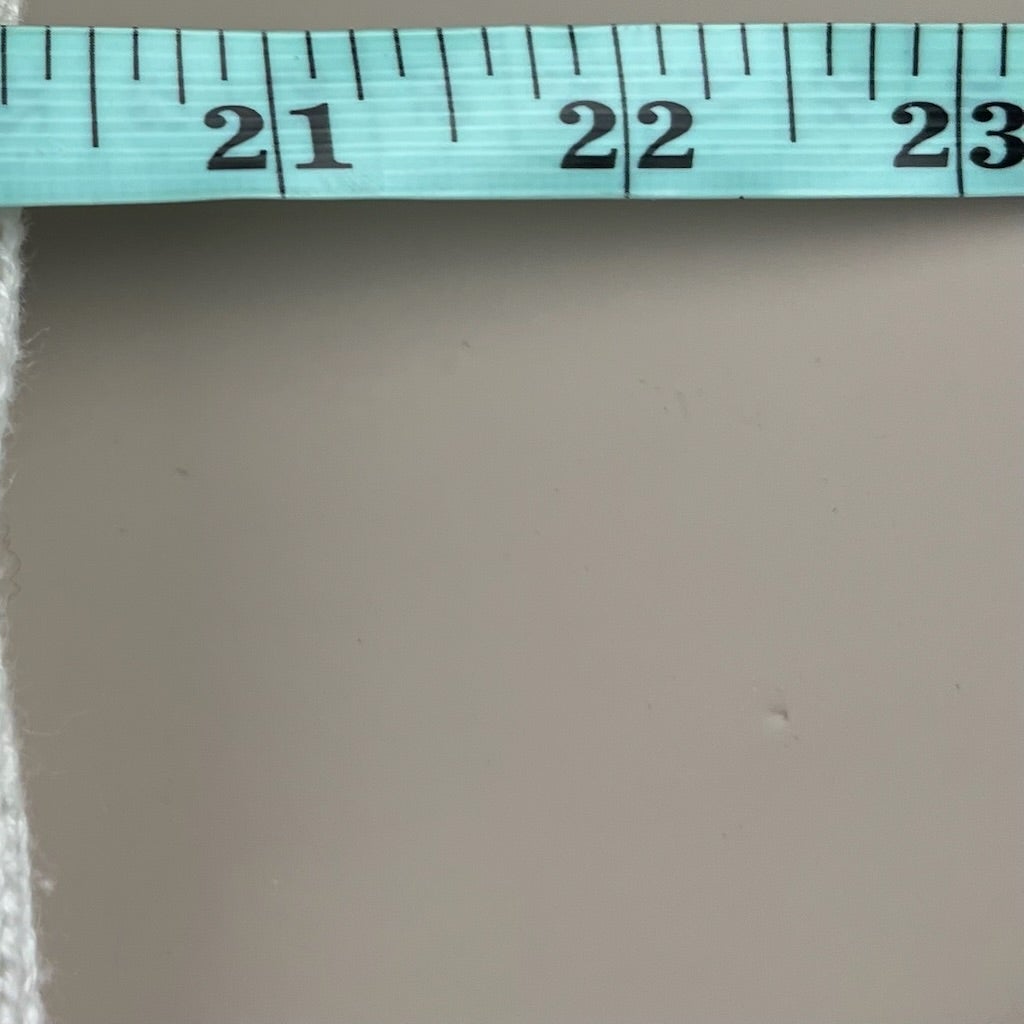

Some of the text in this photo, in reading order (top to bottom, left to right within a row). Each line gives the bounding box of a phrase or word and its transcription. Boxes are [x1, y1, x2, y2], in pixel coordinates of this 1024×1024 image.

[203, 102, 354, 171] 21
[558, 100, 696, 170] 22
[890, 101, 1024, 170] 23
